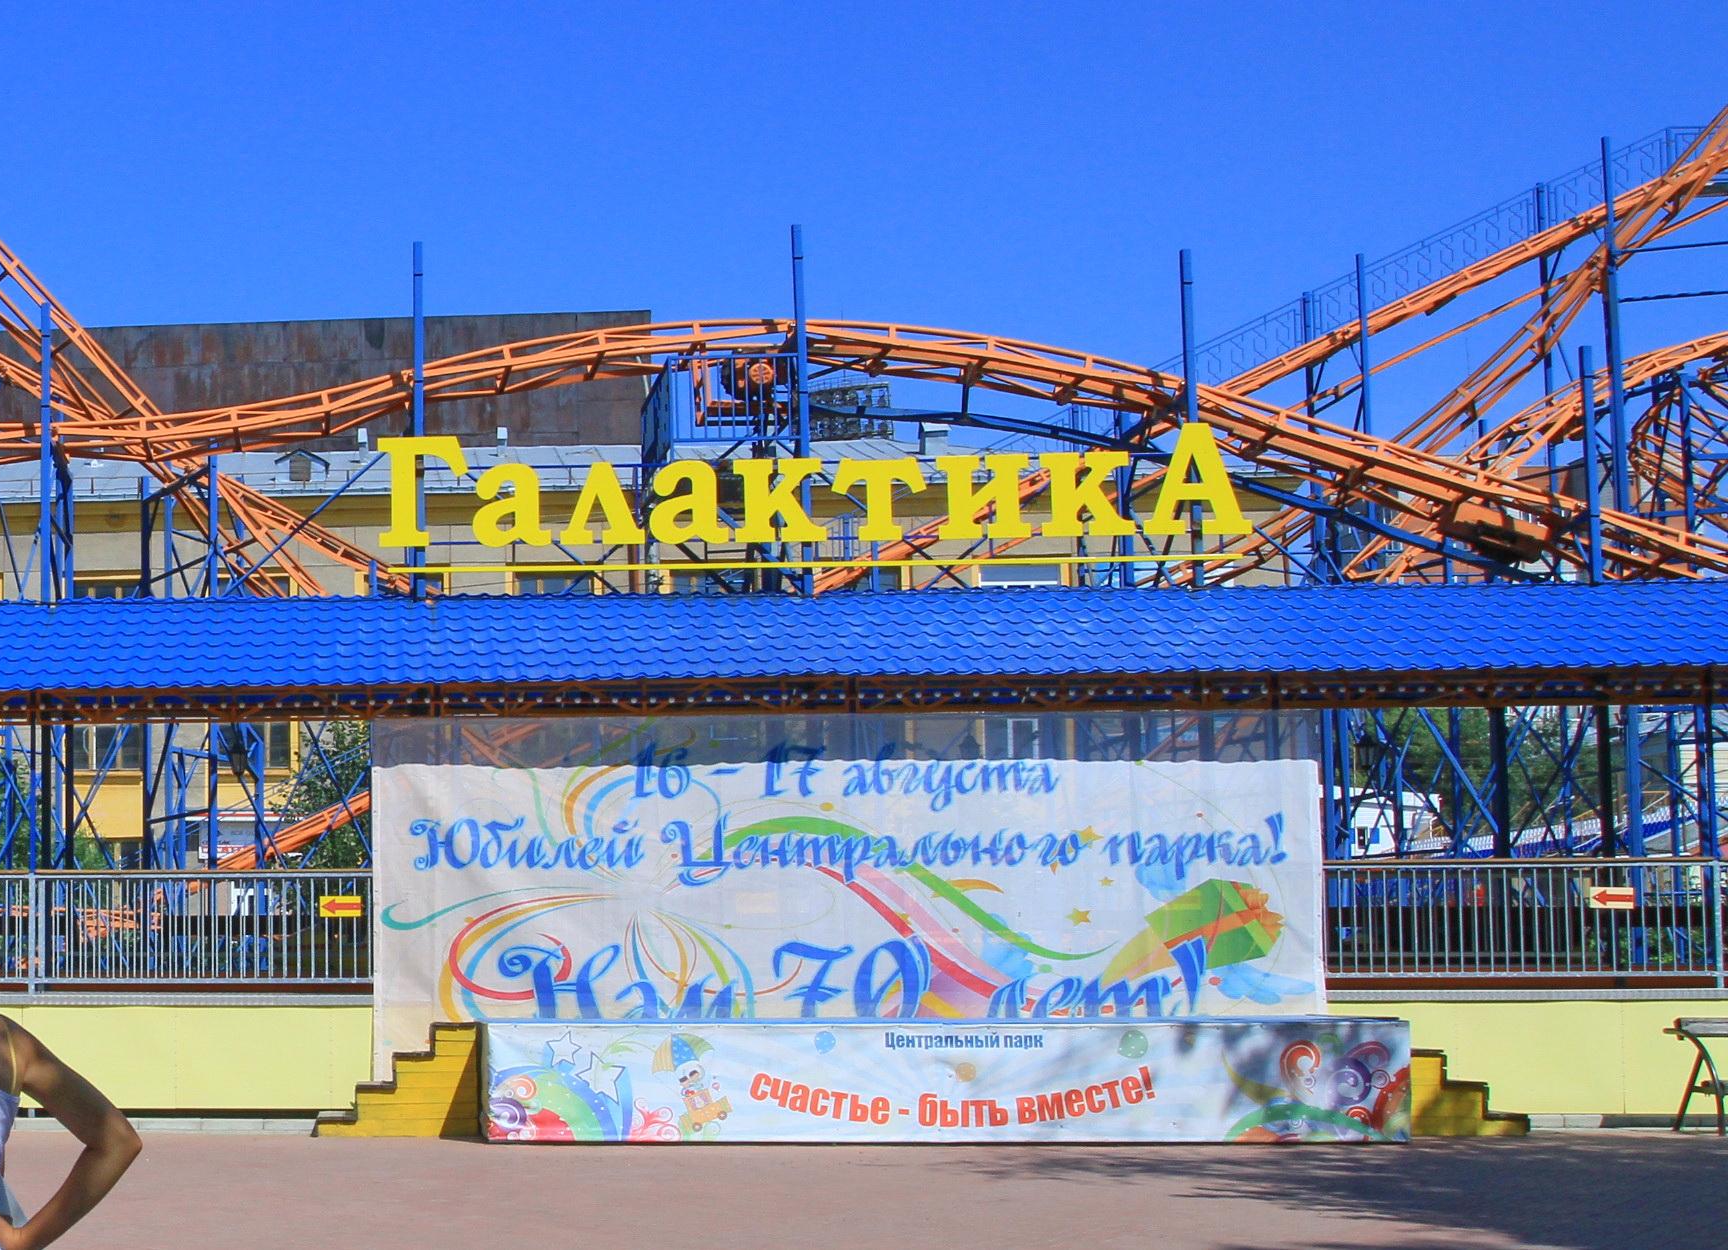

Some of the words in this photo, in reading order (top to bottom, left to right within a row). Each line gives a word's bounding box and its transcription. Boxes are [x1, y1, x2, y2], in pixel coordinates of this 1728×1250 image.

[377, 422, 1253, 548] ГалактикА
[630, 739, 690, 799] 16
[759, 741, 828, 798] 17
[840, 744, 1060, 812] августа
[410, 817, 646, 871] Юбилей
[662, 811, 1088, 886] Центрального
[1103, 812, 1287, 880] парка!
[498, 944, 743, 1019] Нам
[772, 938, 932, 1019] 70
[884, 1031, 999, 1050] Центральный
[1003, 1033, 1044, 1050] парк
[749, 1073, 890, 1125] счастье
[918, 1093, 1009, 1128] быть
[1017, 1066, 1155, 1125] вместе!
